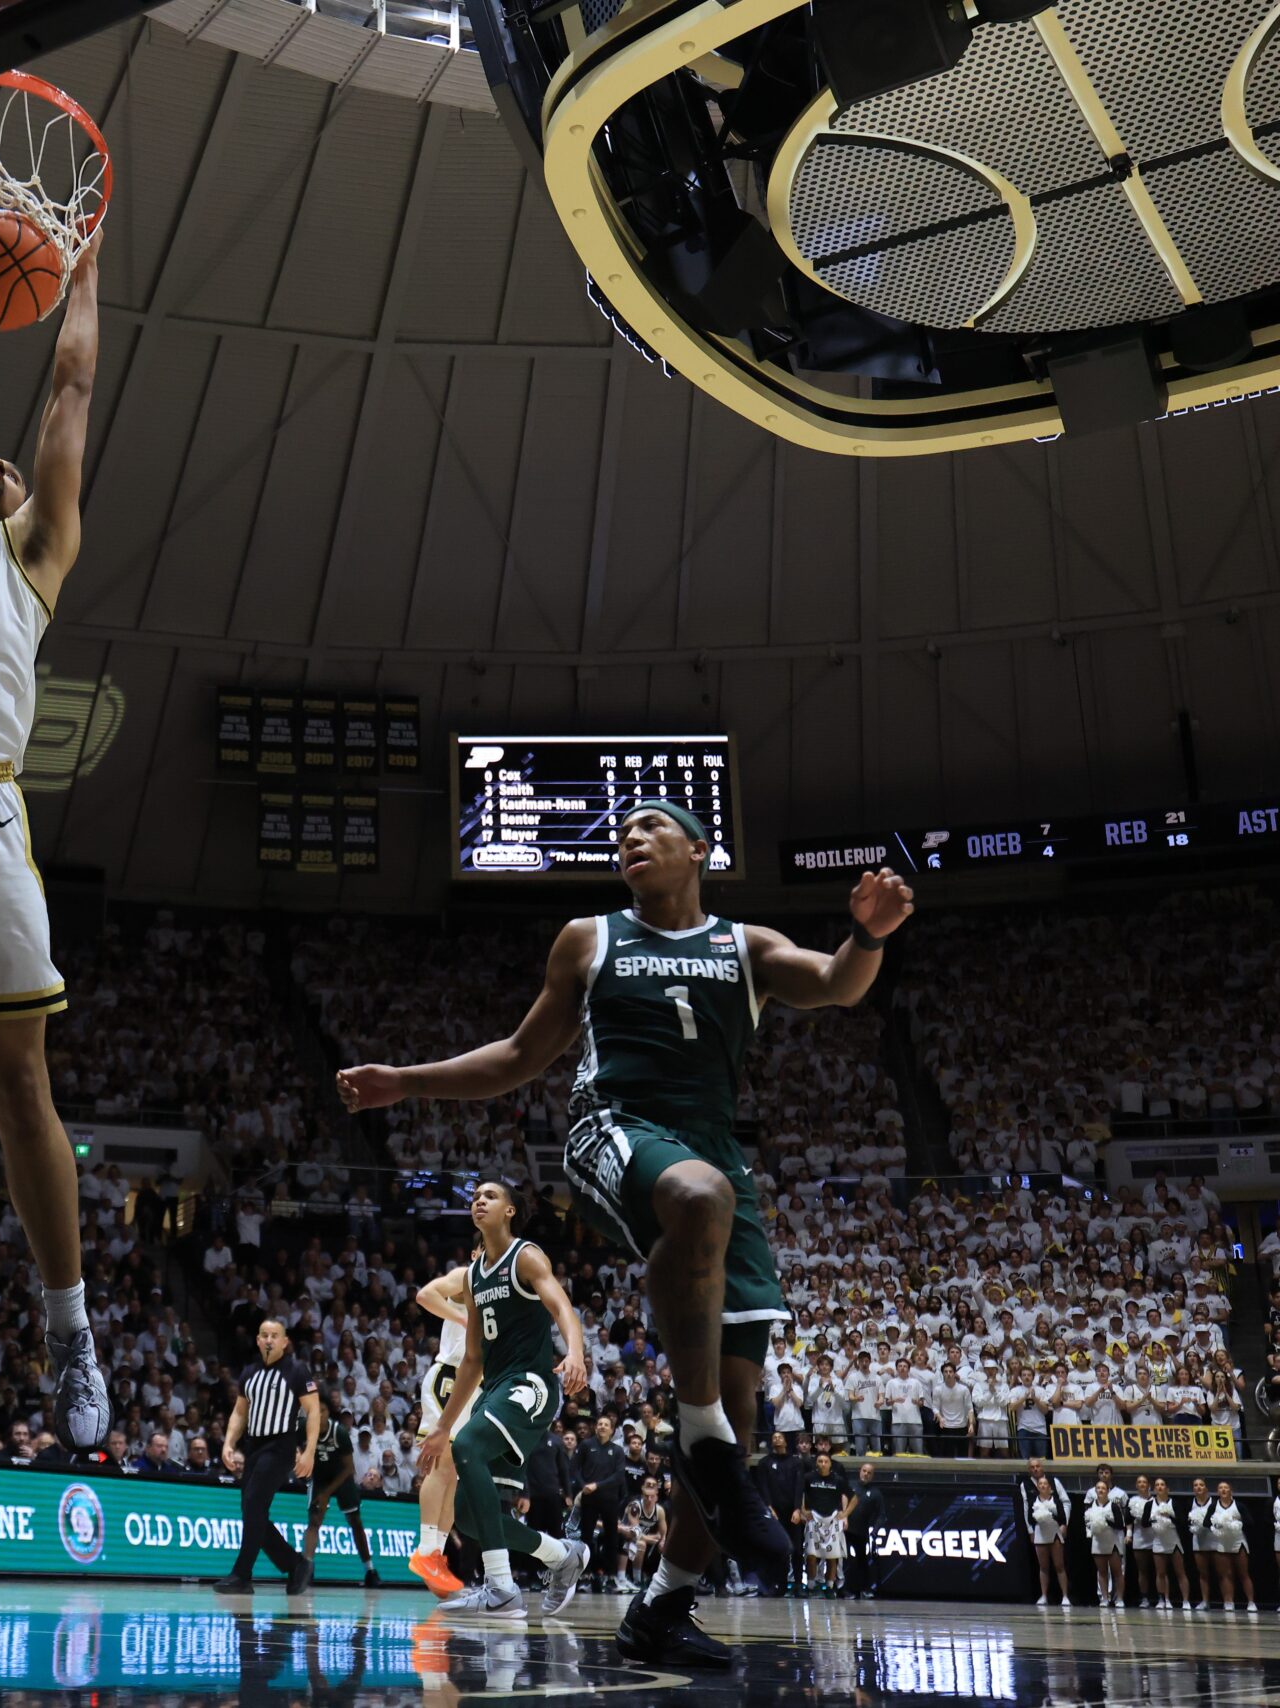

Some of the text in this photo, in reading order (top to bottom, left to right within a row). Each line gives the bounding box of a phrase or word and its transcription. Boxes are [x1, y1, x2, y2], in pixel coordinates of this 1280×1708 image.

[600, 756, 724, 768] PTS REB AST BLK FOUL
[484, 771, 492, 782] 0
[499, 770, 521, 781] Cox
[634, 770, 640, 782] 1
[659, 770, 665, 782] 1
[684, 770, 692, 782] 0
[711, 770, 718, 781] 0
[499, 784, 534, 796] Smith
[634, 785, 642, 796] 4
[685, 785, 693, 796] 0
[712, 785, 719, 796] 2
[484, 798, 720, 811] 4 Kaufman-Renn 7 1 2
[481, 815, 493, 826] 14
[500, 813, 540, 825] Benter
[713, 814, 721, 825] 0
[1164, 811, 1186, 824] 21
[1238, 808, 1279, 835] AST
[482, 830, 493, 842] 17
[501, 829, 538, 843] Mayer
[714, 830, 722, 842] 0
[1040, 824, 1051, 835] 7
[1105, 820, 1148, 846] REB
[967, 832, 1022, 858] OREB
[1166, 834, 1189, 847] 18
[794, 846, 887, 869] #BOILERUP
[1043, 846, 1054, 857] 4
[614, 956, 739, 983] SPARTANS
[664, 985, 698, 1039] 1
[483, 1306, 498, 1340] 6
[1154, 1428, 1190, 1442] LIVES
[1215, 1431, 1229, 1448] 5
[1053, 1428, 1154, 1458] DEFENSE
[1155, 1443, 1193, 1459] HERE
[1195, 1451, 1233, 1459] PLAY HARD
[124, 1512, 173, 1546] OLD
[377, 1528, 417, 1557] LINE
[853, 1526, 1007, 1563] EATGEEK
